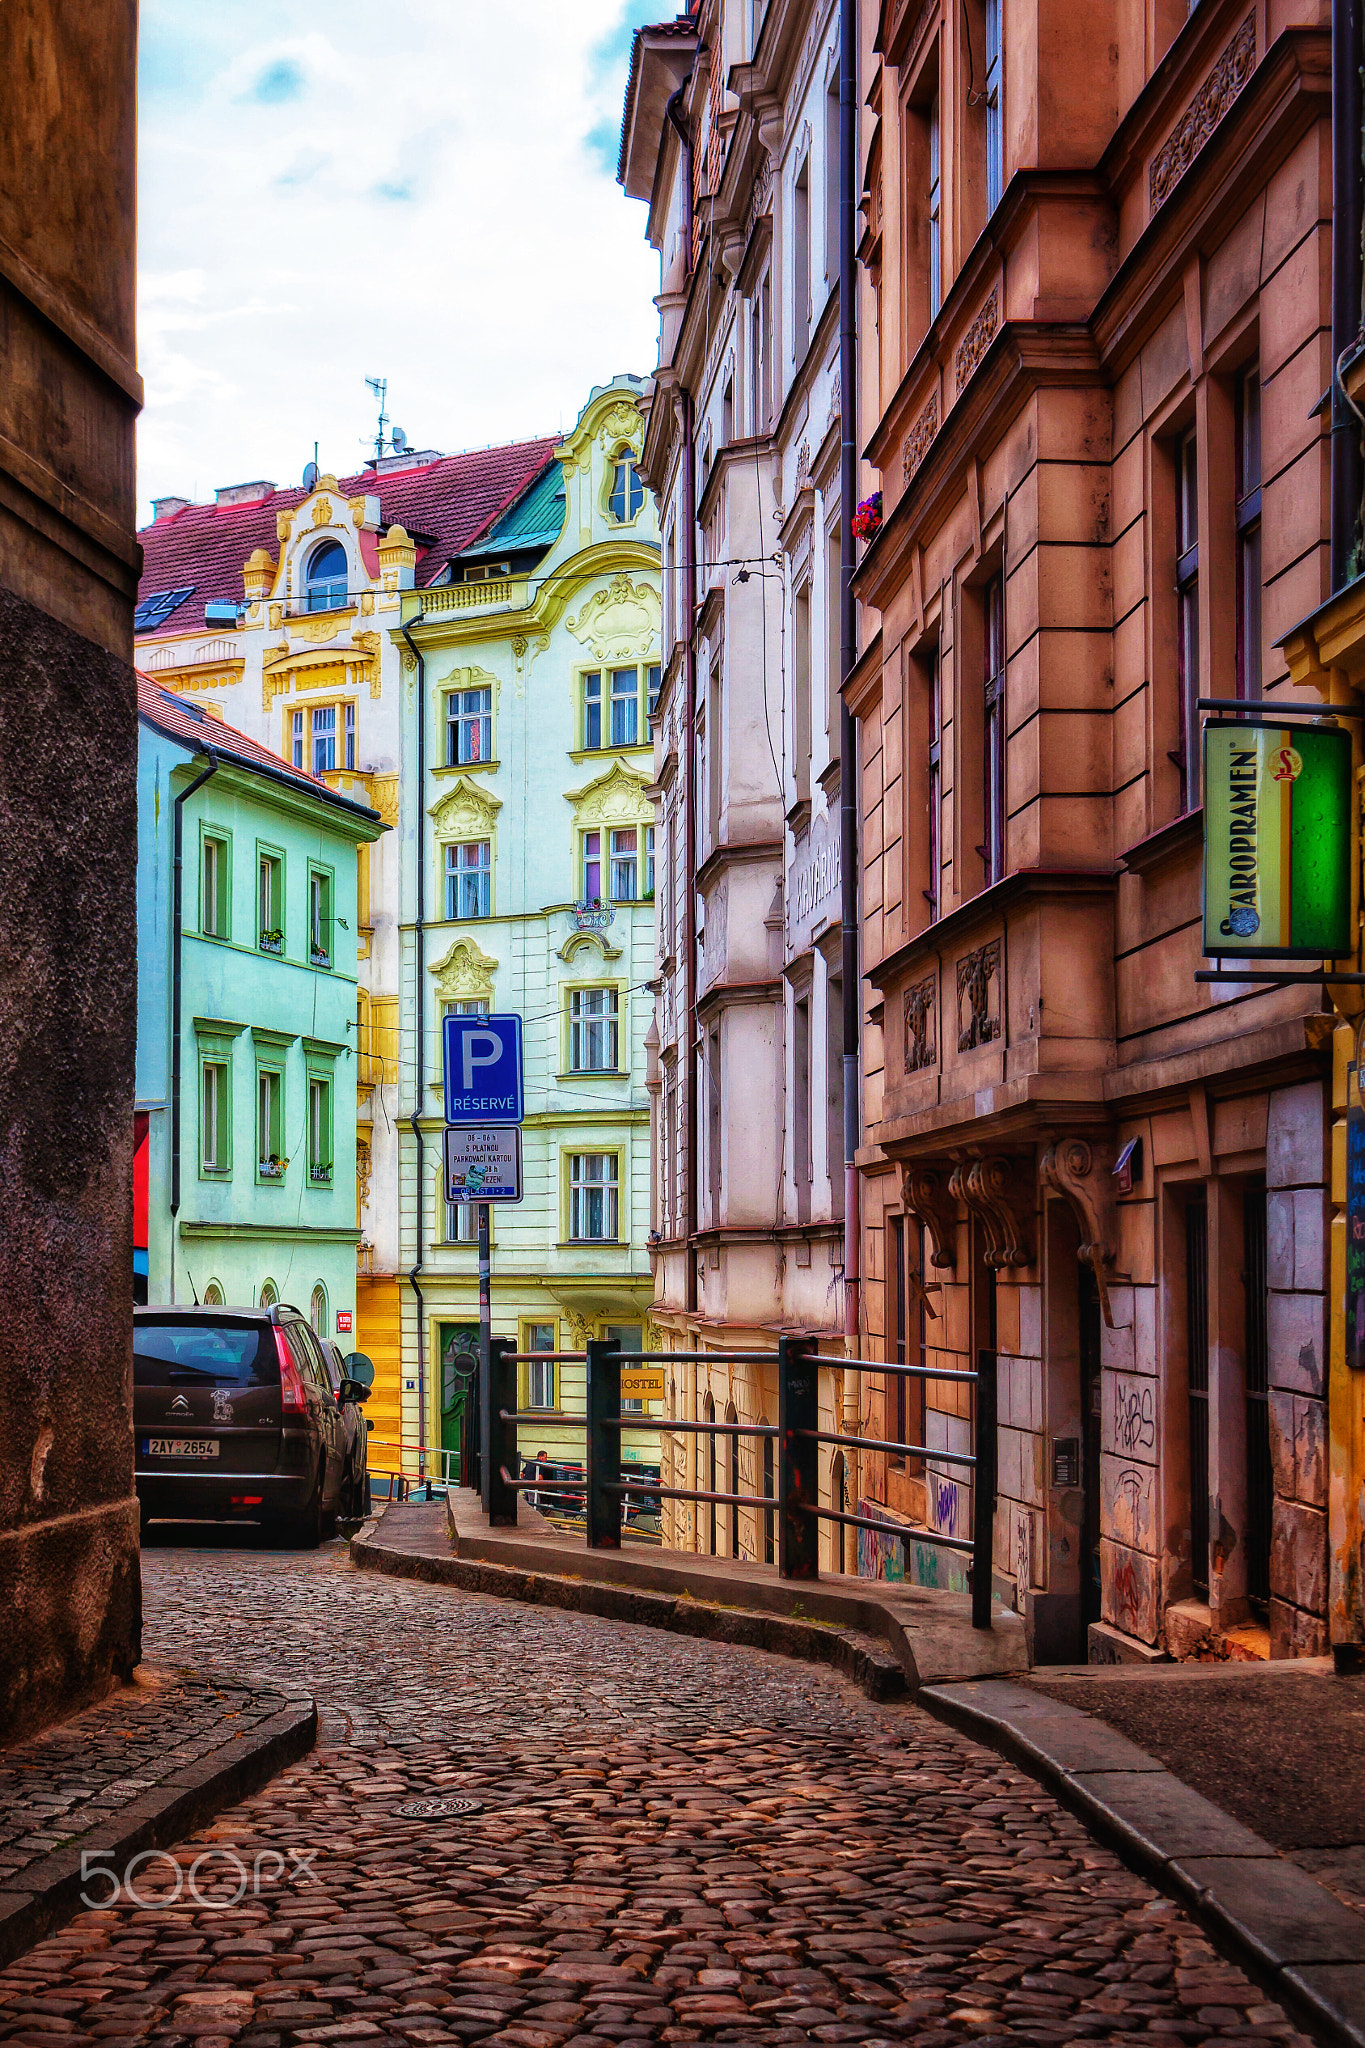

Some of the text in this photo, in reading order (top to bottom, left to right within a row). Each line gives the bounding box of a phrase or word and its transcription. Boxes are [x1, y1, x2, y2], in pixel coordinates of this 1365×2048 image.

[1220, 751, 1257, 937] AROPRAMEN
[462, 1030, 504, 1090] P
[453, 1094, 516, 1110] RÉSERVÉ
[466, 1144, 499, 1152] S PLATNOU
[453, 1153, 512, 1163] PARKOVACÍ KARTOU
[151, 1440, 214, 1455] 2AY 2654
